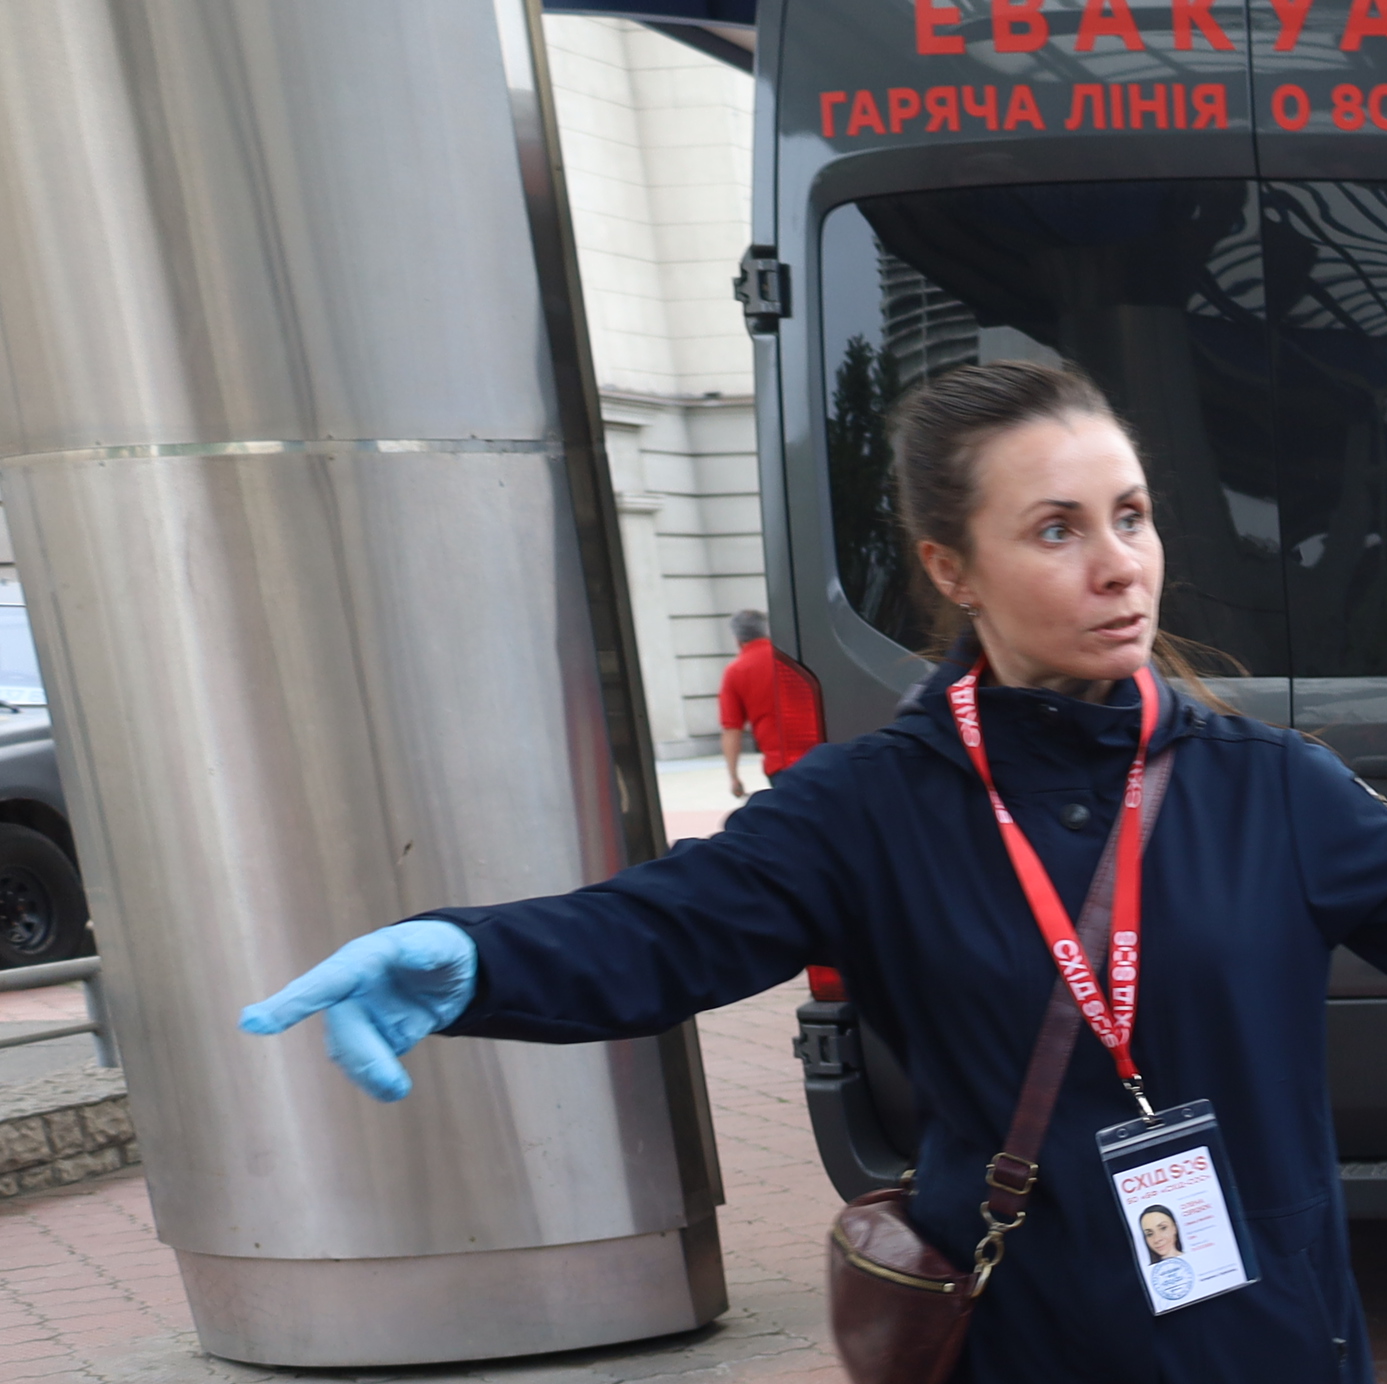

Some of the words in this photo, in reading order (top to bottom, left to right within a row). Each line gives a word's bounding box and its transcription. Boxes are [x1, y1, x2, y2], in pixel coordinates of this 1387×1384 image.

[820, 85, 1046, 137] ГАРЯЧА
[1065, 83, 1228, 131] ЛІНІЯ
[1271, 84, 1311, 132] 0
[1121, 1169, 1168, 1193] СХІД
